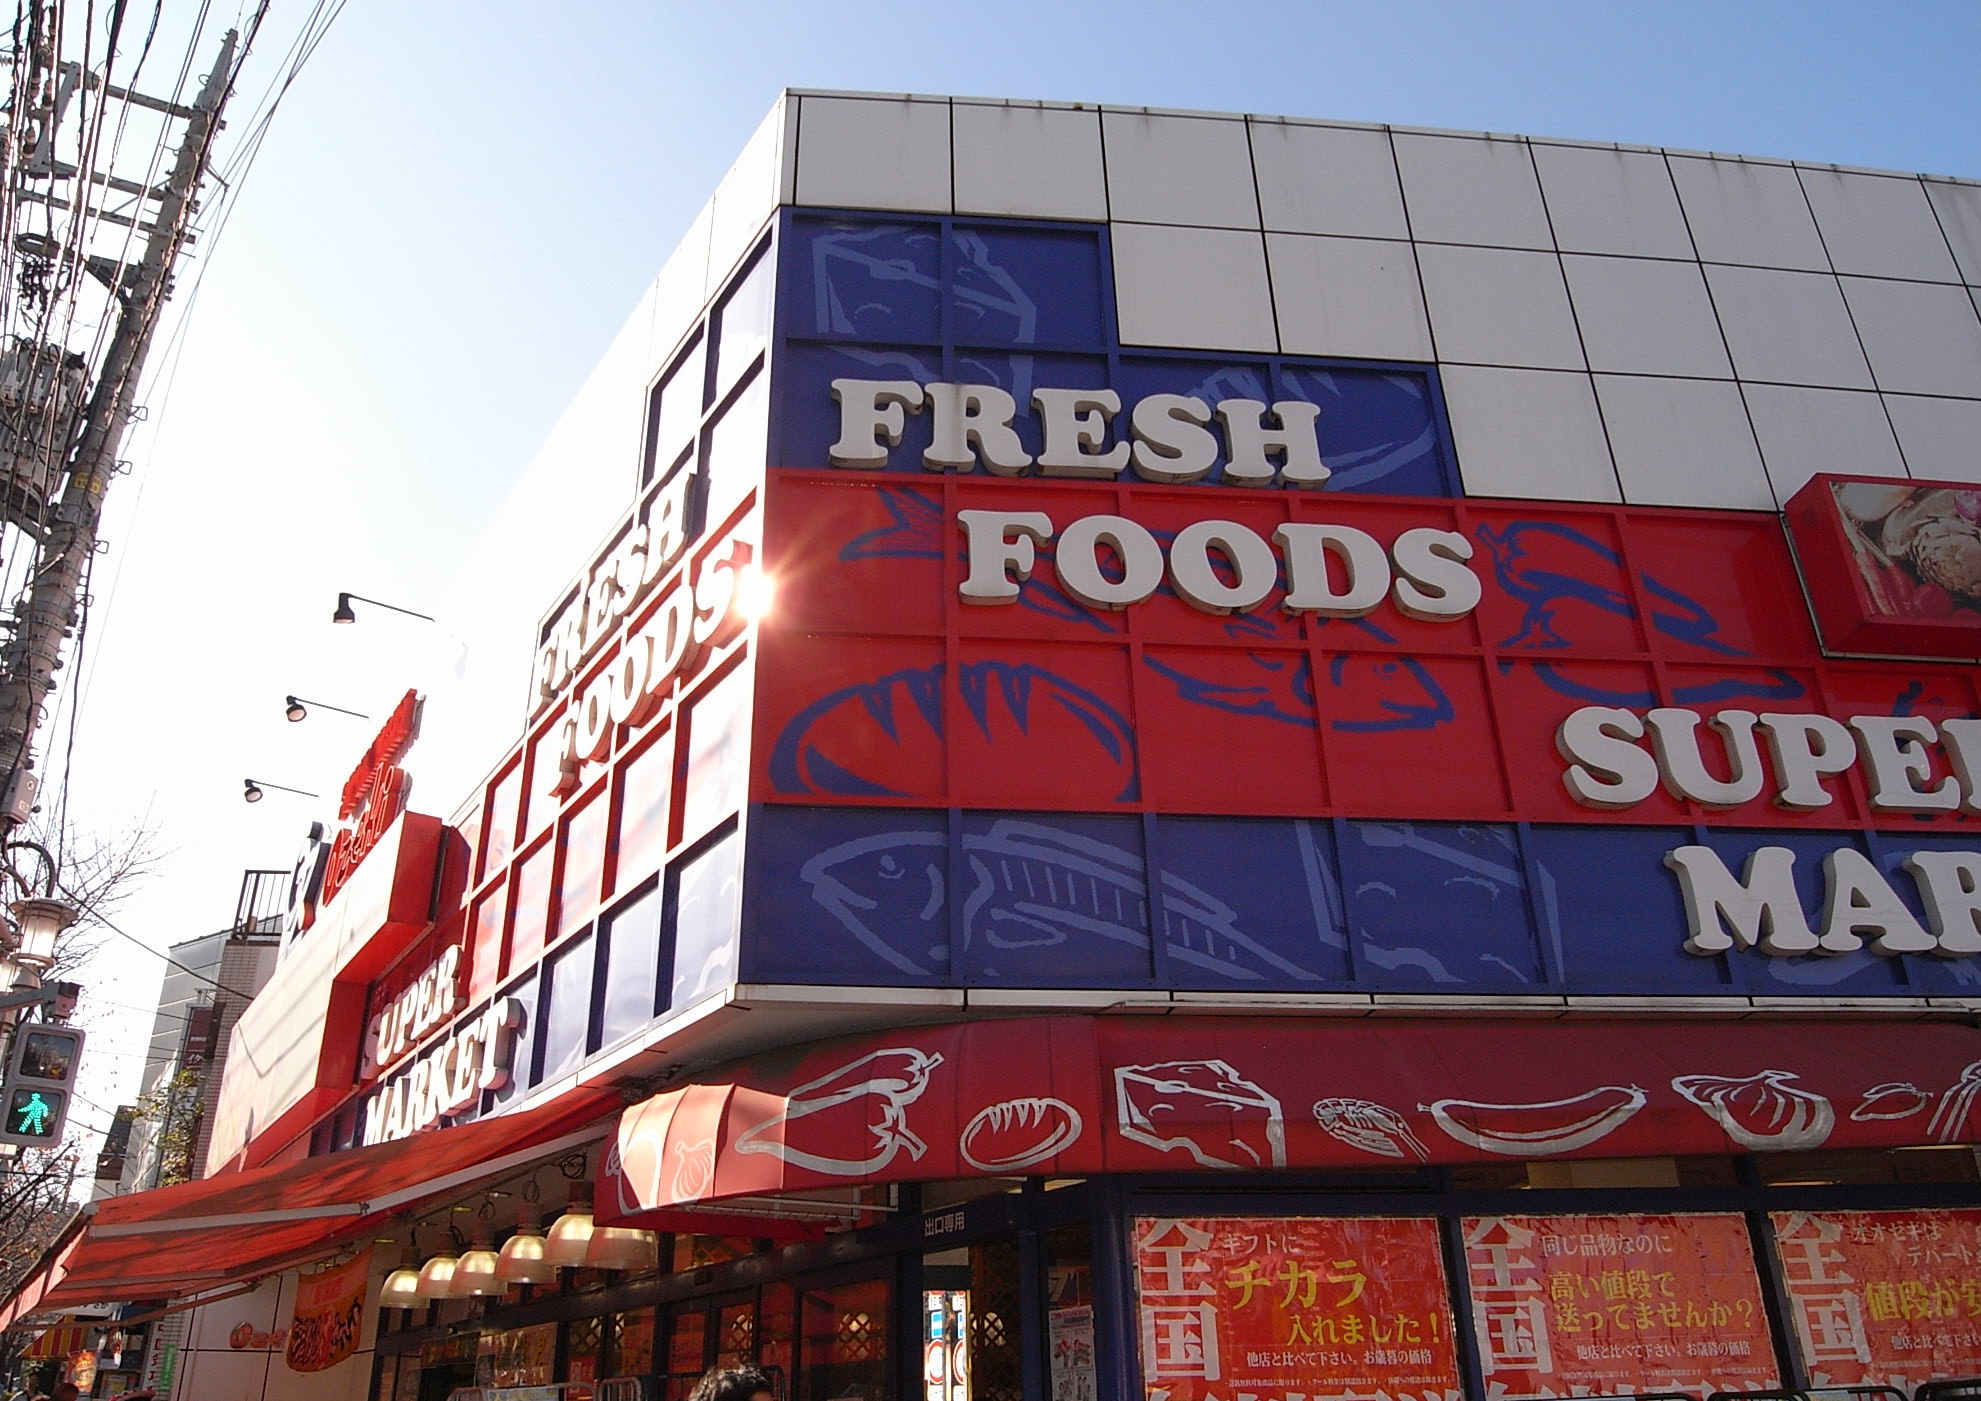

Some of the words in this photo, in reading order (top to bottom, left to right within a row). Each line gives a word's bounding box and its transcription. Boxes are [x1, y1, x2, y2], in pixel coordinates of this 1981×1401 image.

[830, 378, 1331, 488] FRESH
[957, 510, 1482, 622] FOODS
[553, 536, 753, 796] FOODS
[361, 945, 466, 1079] SUPER
[363, 996, 522, 1146] MARKET
[923, 1211, 965, 1238] 出口専用
[1222, 1233, 1300, 1256] ギフトに
[1541, 1233, 1672, 1257] 同じ品物なのに
[1139, 1218, 1221, 1382] 全国
[1225, 1259, 1367, 1310] チカラ
[1286, 1312, 1441, 1347] 入れました！
[1463, 1217, 1553, 1376] 全国
[1550, 1271, 1676, 1300] 高い値段で
[1555, 1298, 1754, 1333] 送ってませんか？
[1773, 1211, 1872, 1367] 全国
